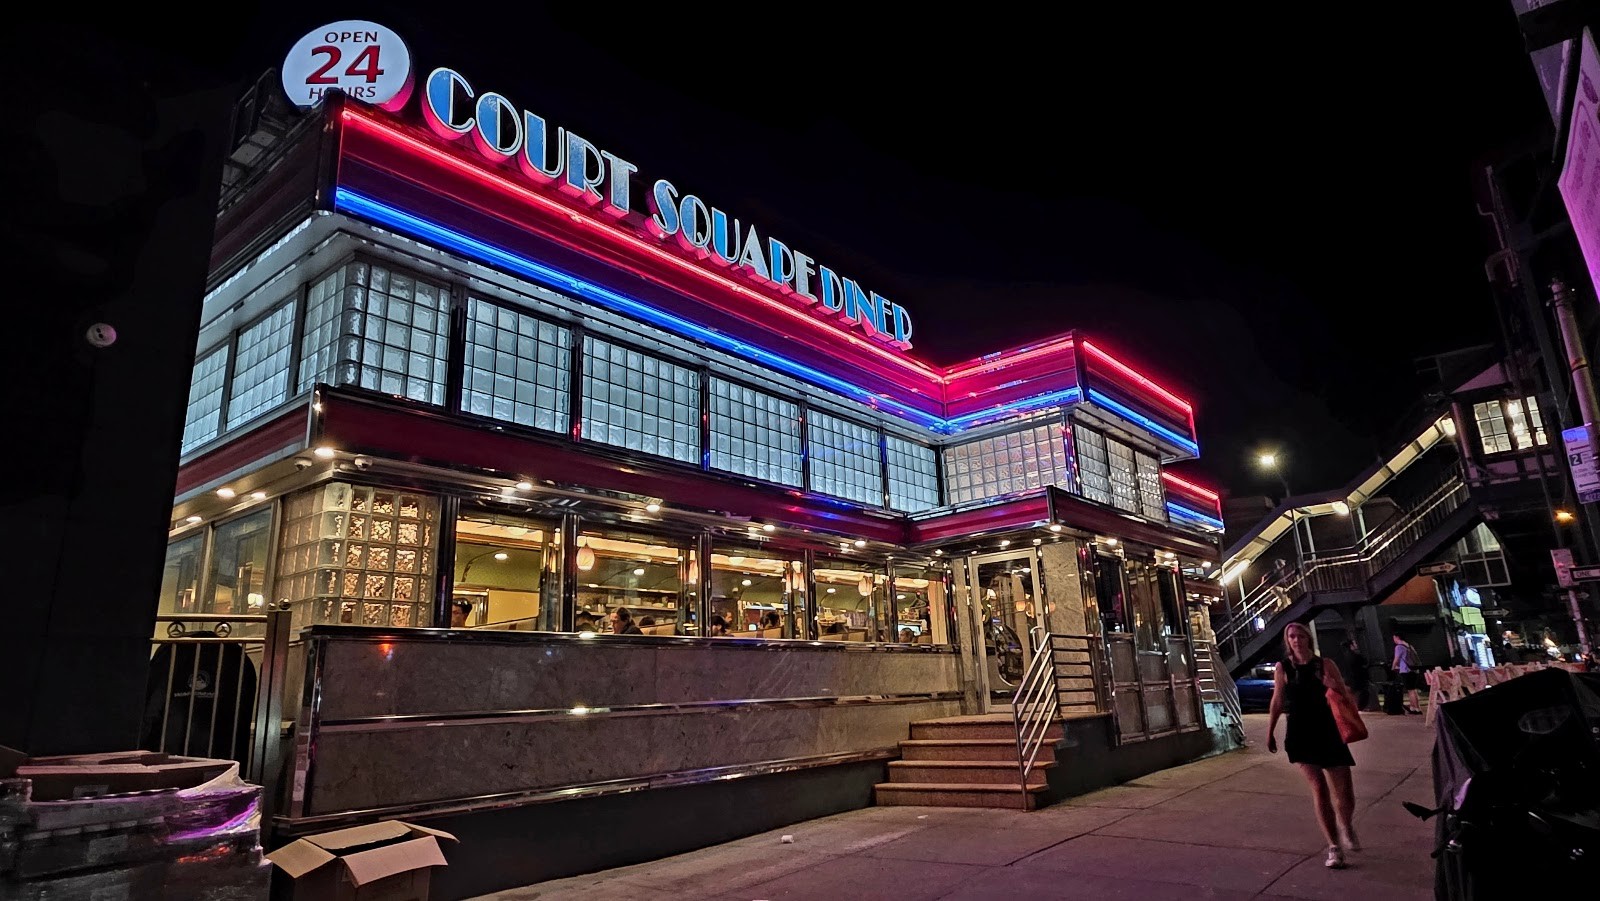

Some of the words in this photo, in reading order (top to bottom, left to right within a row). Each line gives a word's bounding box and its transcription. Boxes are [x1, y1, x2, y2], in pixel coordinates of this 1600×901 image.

[324, 31, 378, 43] OPEN
[305, 44, 385, 85] 24
[308, 86, 376, 100] HURS
[426, 66, 638, 214] COURT
[652, 179, 819, 304] SQUARE
[819, 264, 913, 343] DINER
